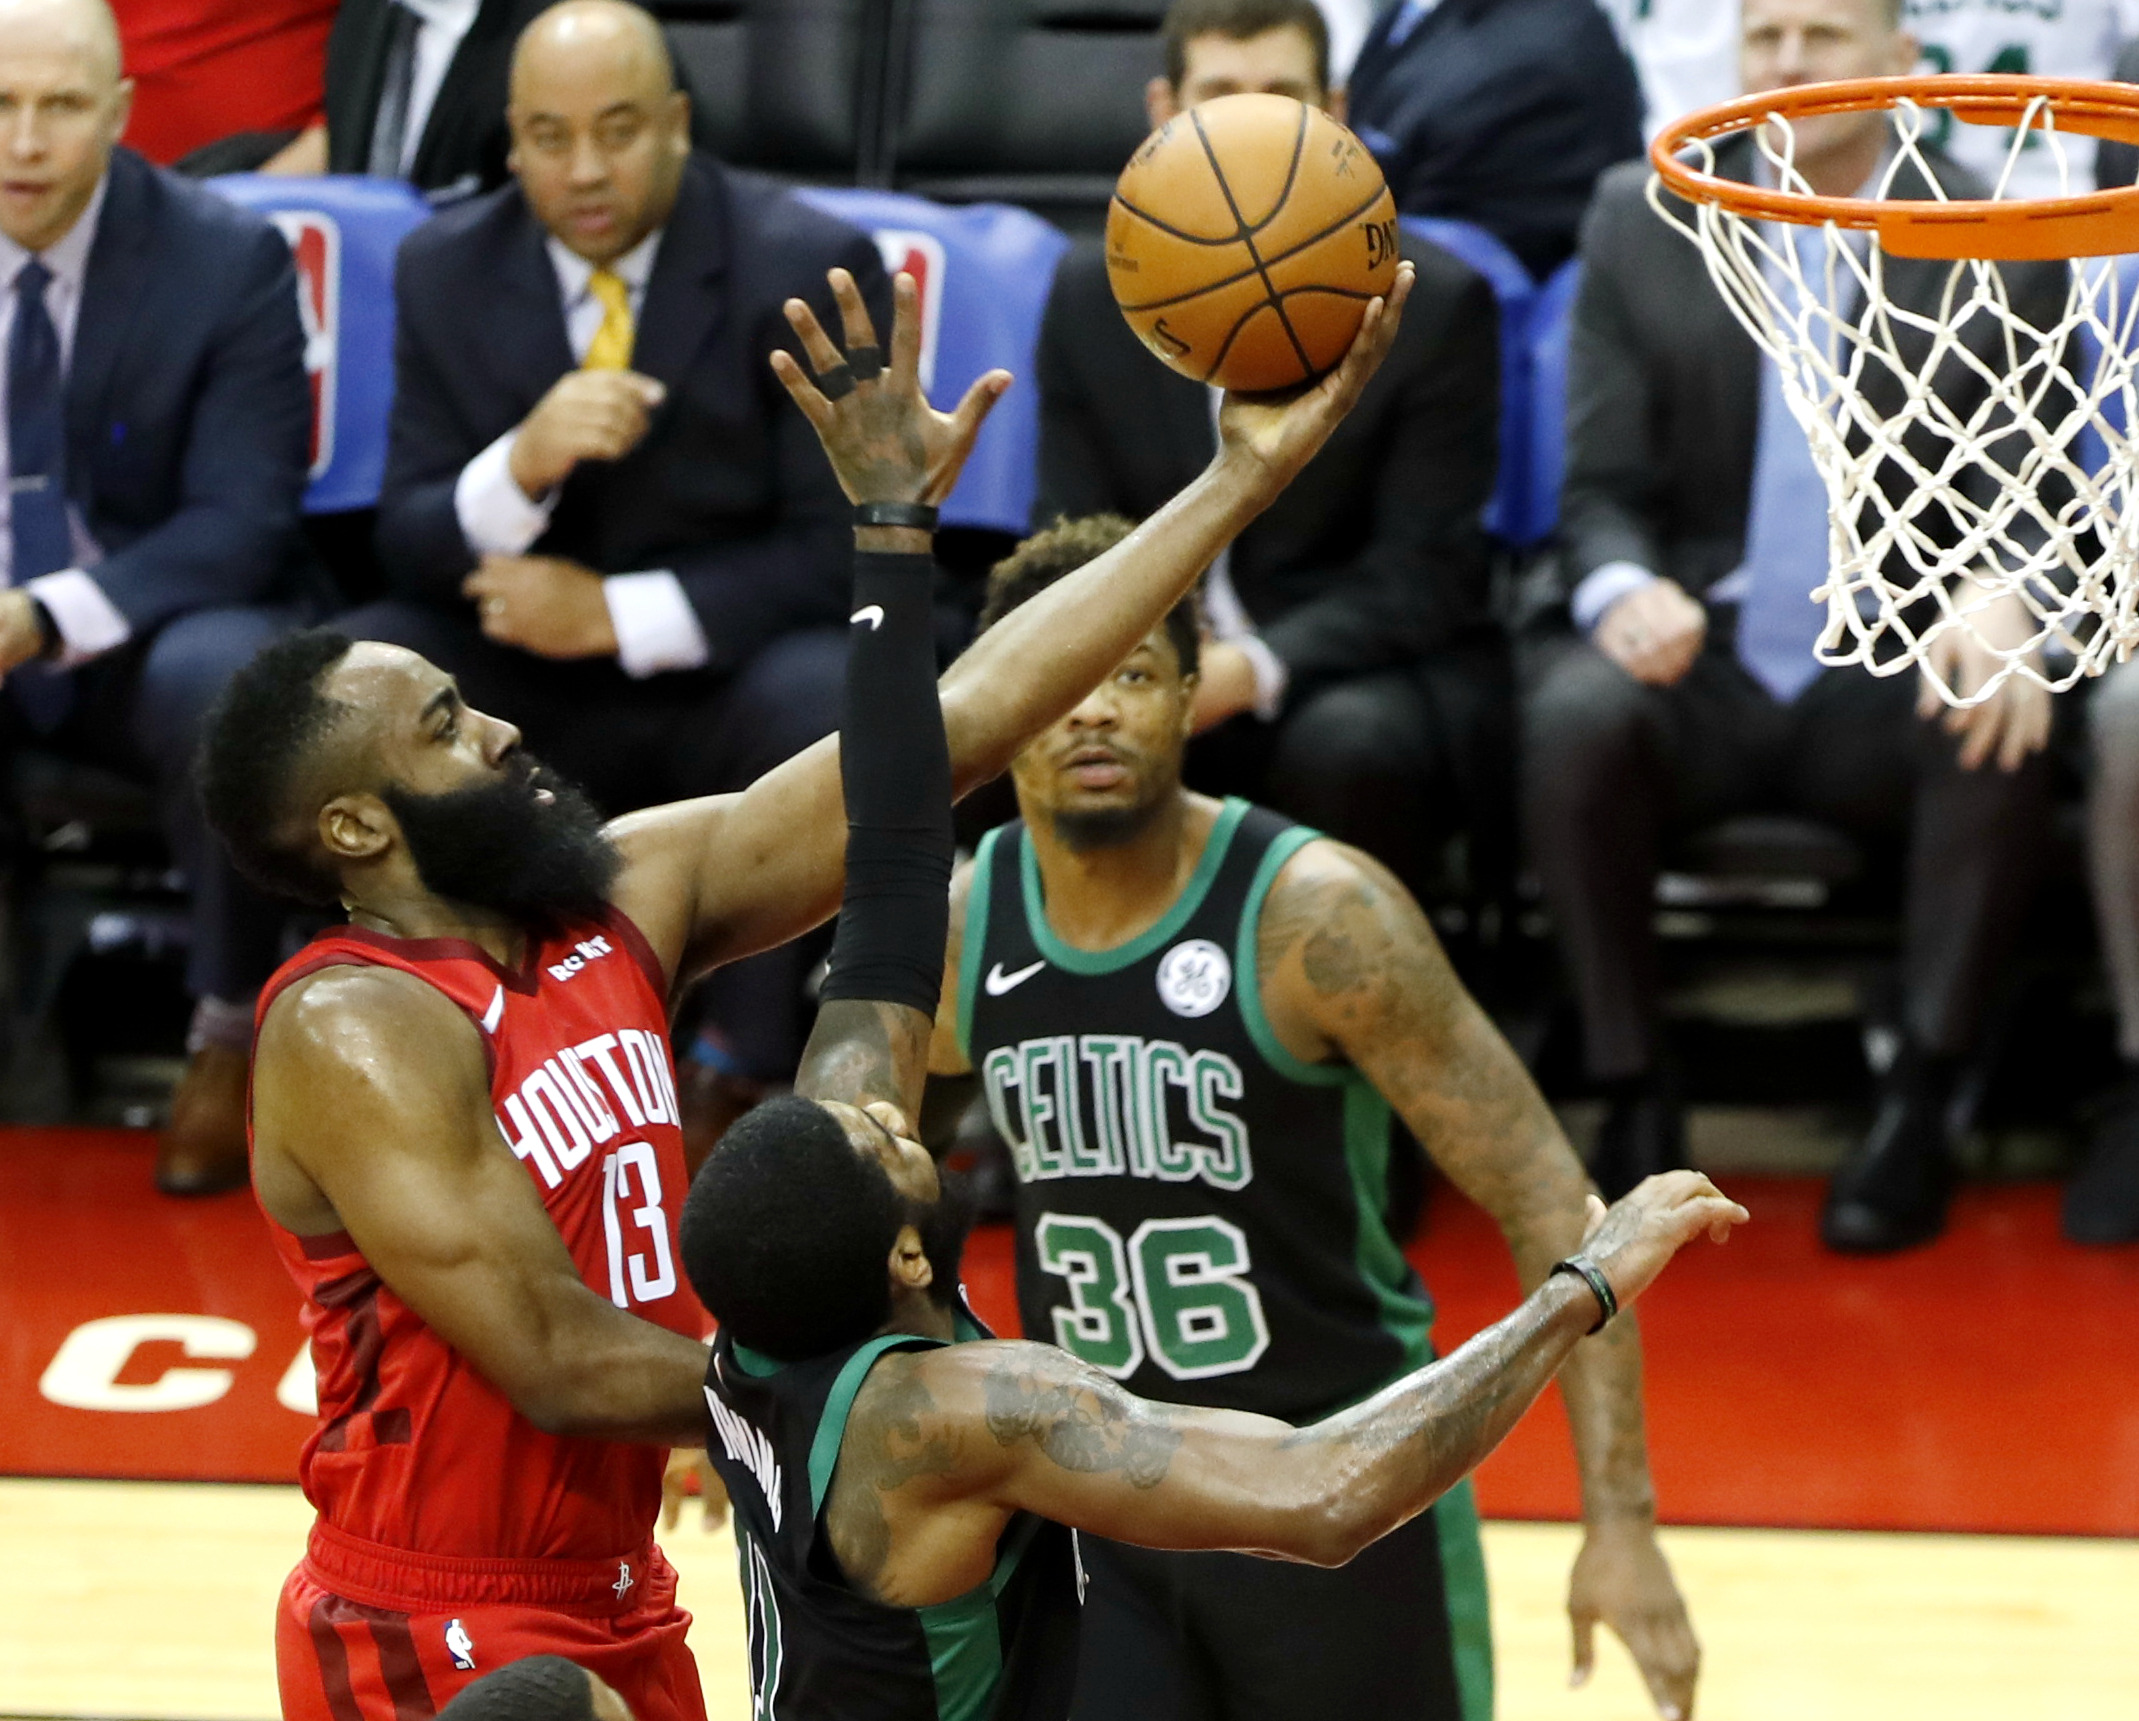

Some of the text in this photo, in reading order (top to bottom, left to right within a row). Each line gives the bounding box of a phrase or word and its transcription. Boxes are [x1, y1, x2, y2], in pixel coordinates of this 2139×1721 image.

[983, 1034, 1253, 1192] CELTICS
[603, 1141, 677, 1308] 13
[1035, 1212, 1271, 1380] 36
